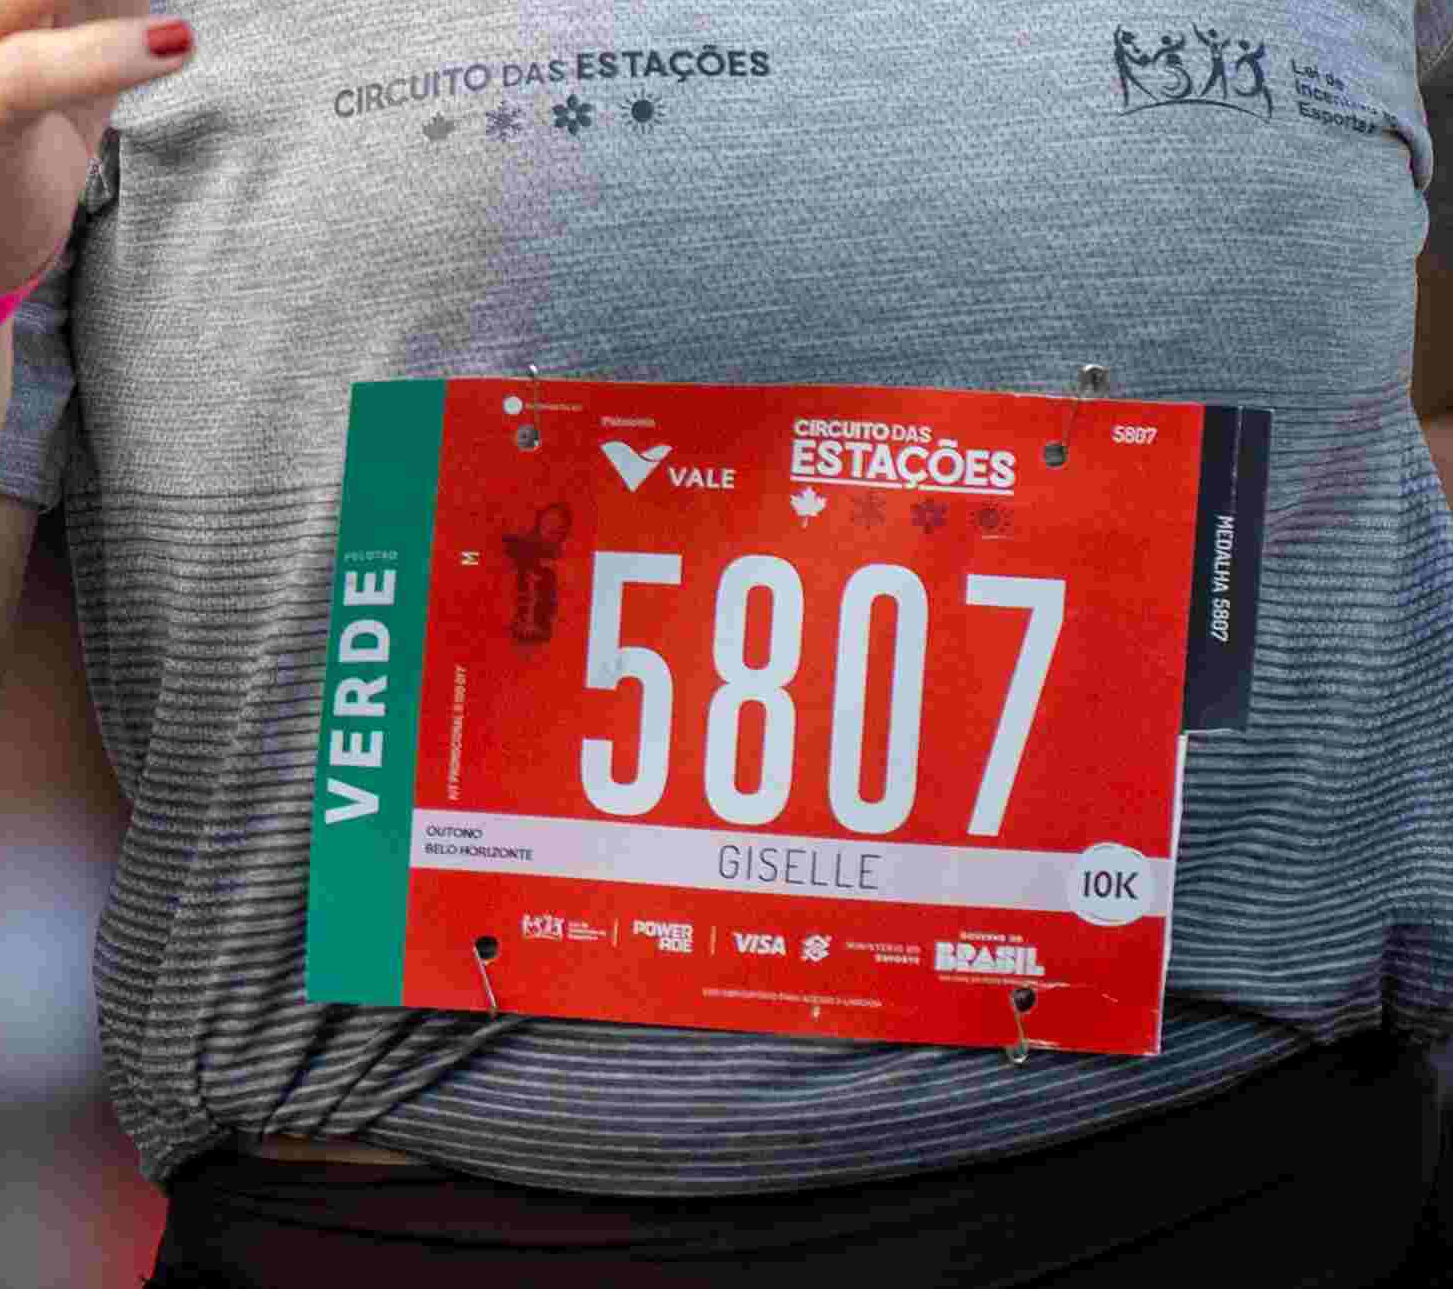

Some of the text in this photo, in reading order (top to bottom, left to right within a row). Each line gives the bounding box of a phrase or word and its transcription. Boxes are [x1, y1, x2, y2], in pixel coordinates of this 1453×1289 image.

[334, 44, 770, 118] CIRCUITO DAS ESTAÇÕES
[794, 419, 932, 443] CIRCUITO DAS
[1112, 425, 1158, 445] 5807
[791, 438, 1016, 489] ESTAÇÕES
[667, 466, 736, 490] VALE
[1210, 515, 1234, 642] MEDALHA 5807
[325, 569, 397, 824] VERDE
[580, 549, 1067, 837] 5807
[426, 825, 482, 839] OUTONO
[425, 842, 534, 862] BELO HORIZONTE
[718, 845, 881, 890] GISELLE
[1082, 871, 1138, 899] 10K
[632, 919, 693, 938] POWER
[735, 932, 787, 956] VISA
[934, 941, 1045, 975] BRASIL
